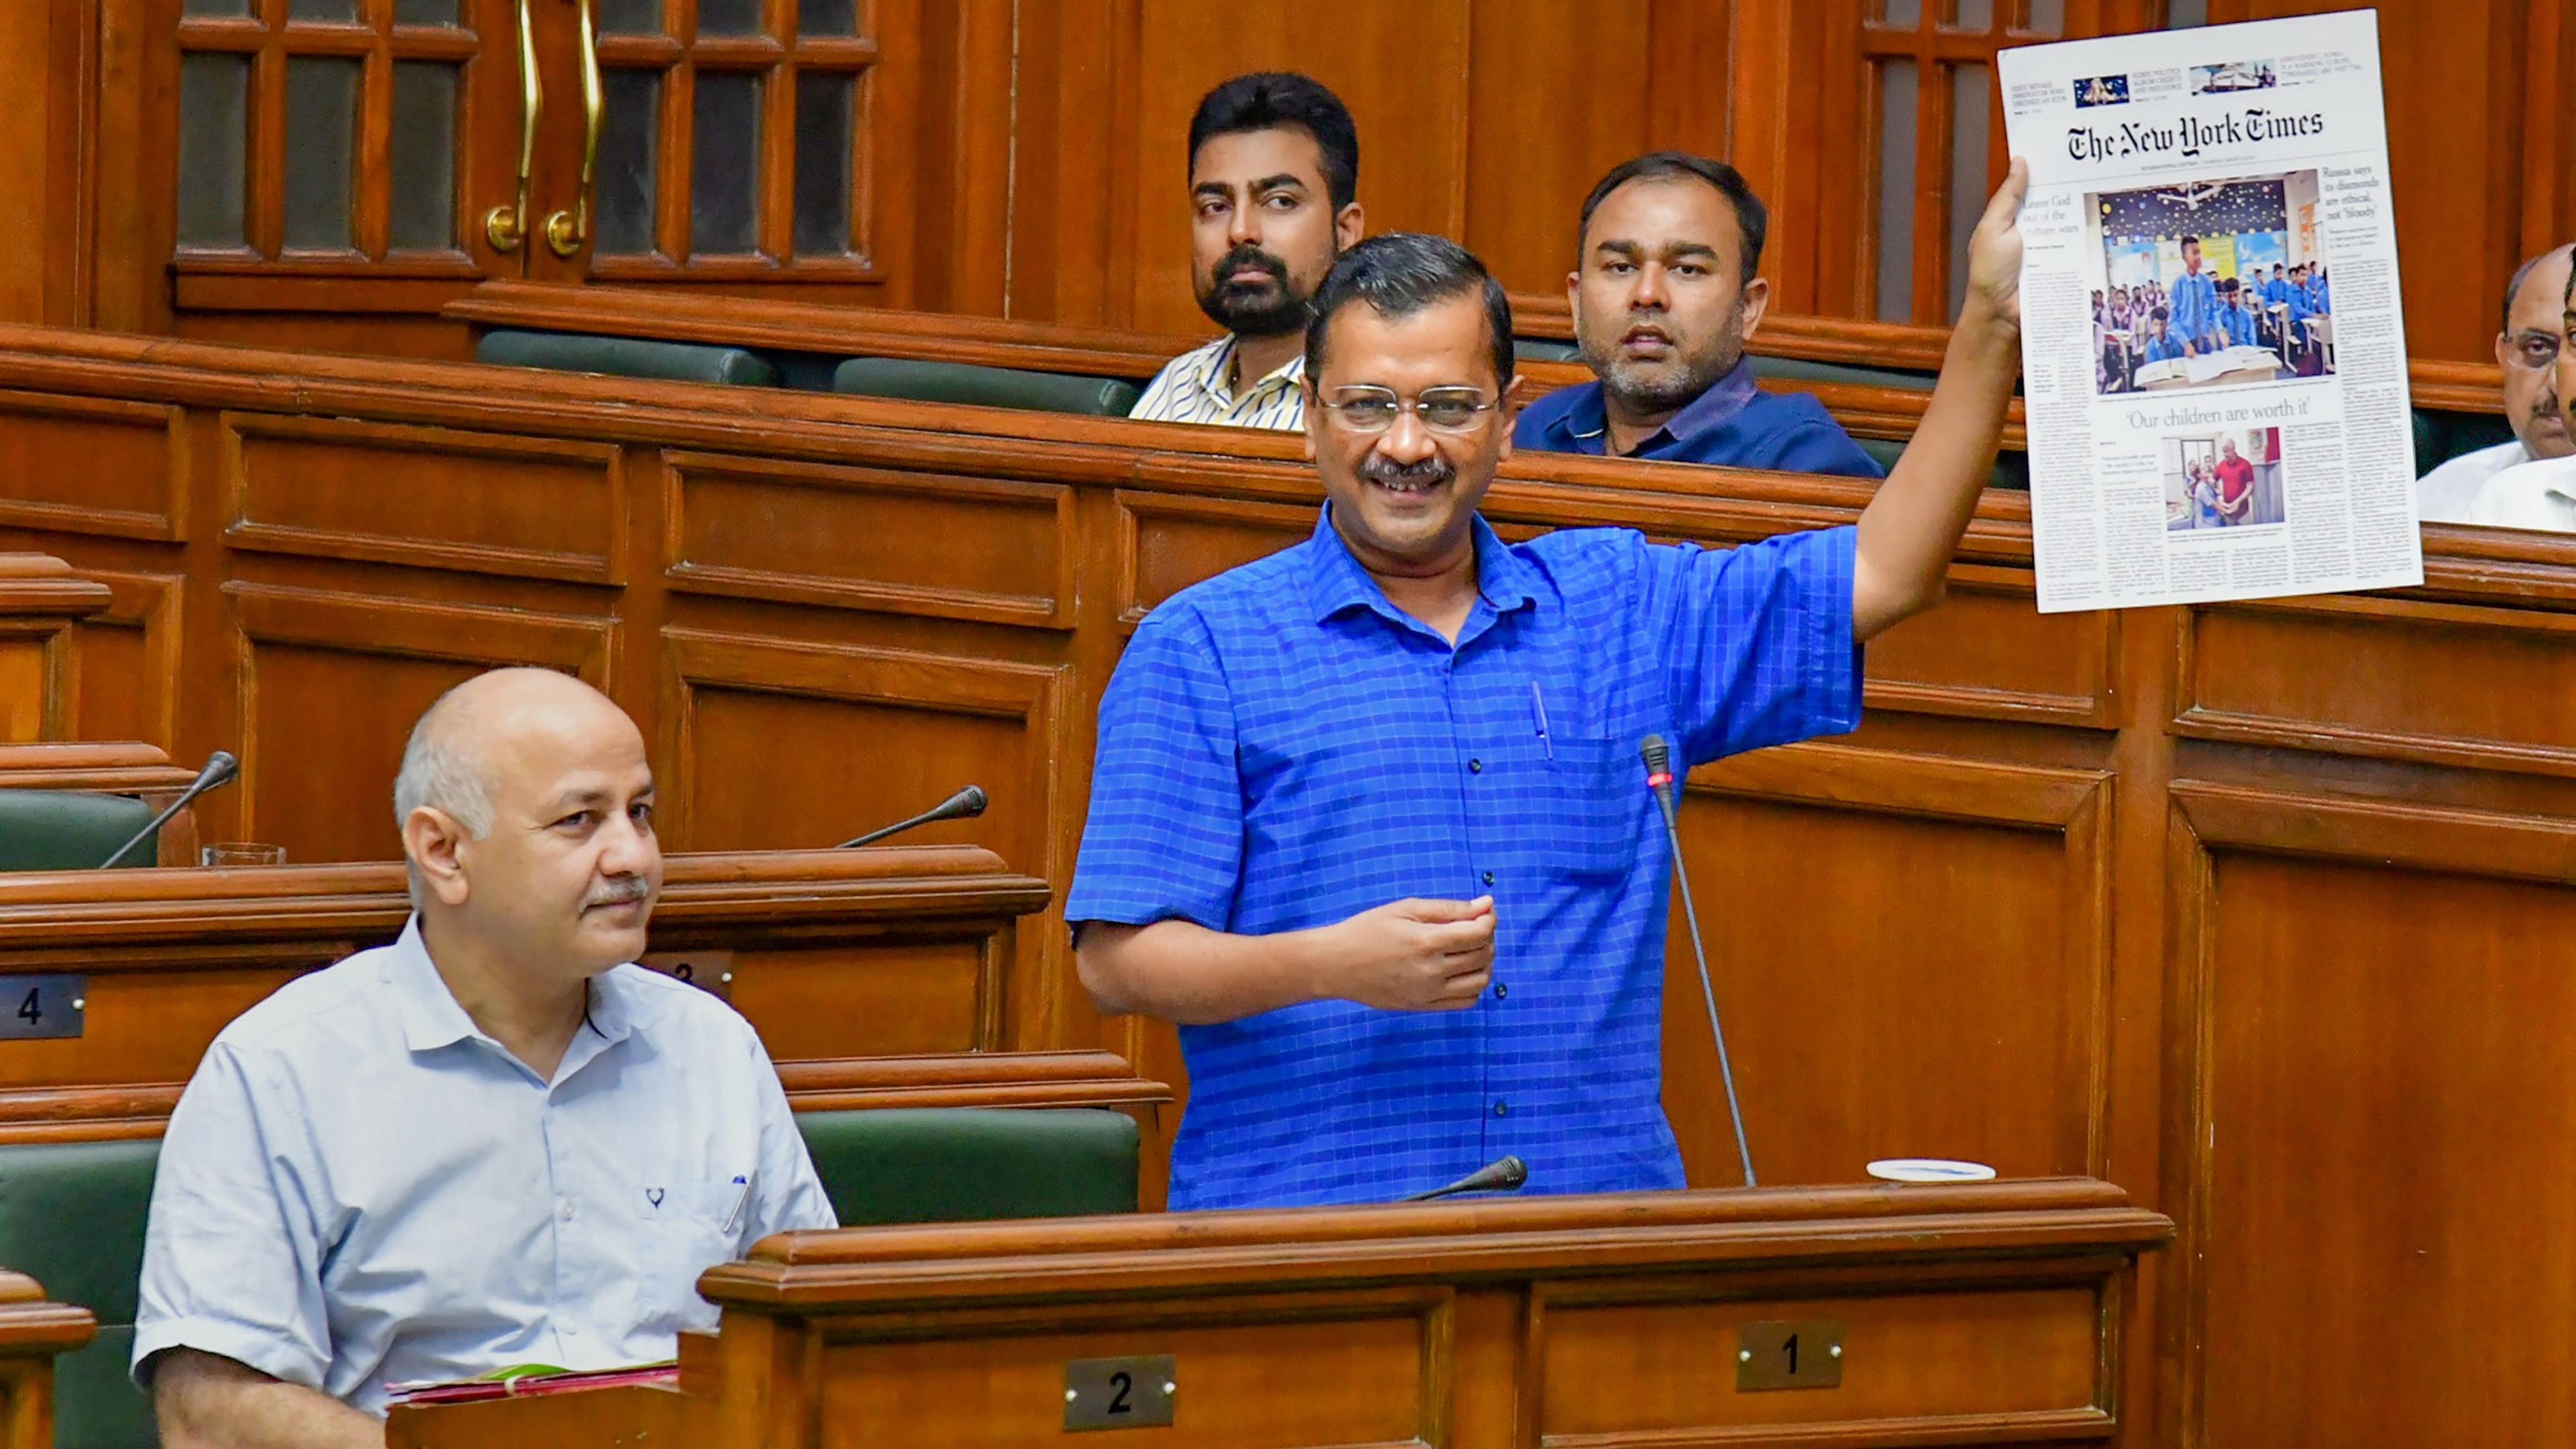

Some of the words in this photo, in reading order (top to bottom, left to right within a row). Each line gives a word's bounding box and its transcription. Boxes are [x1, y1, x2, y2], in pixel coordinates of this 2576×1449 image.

[2068, 126, 2114, 163] The
[2120, 122, 2173, 158] New
[2179, 112, 2242, 157] York
[2246, 107, 2324, 141] Times
[2163, 407, 2221, 427] children
[2226, 408, 2249, 421] are
[2252, 398, 2294, 419] worth
[18, 987, 42, 1025] 4
[1783, 1333, 1798, 1373] 1
[1108, 1372, 1131, 1414] 2
